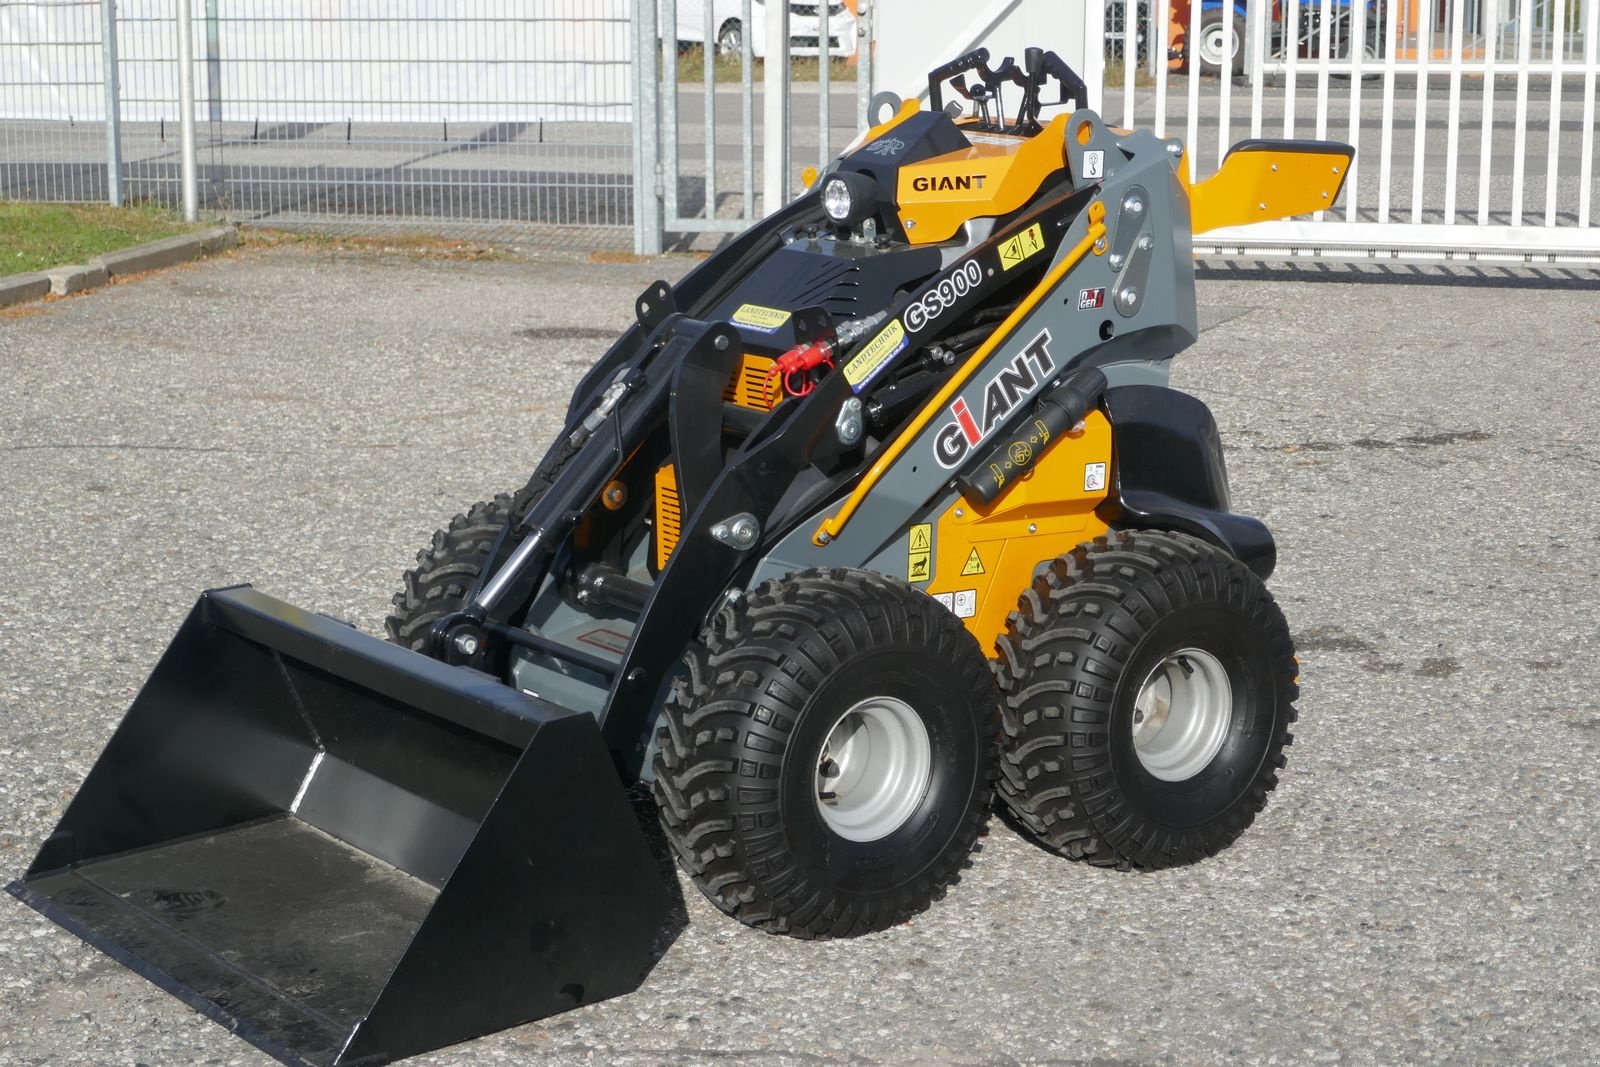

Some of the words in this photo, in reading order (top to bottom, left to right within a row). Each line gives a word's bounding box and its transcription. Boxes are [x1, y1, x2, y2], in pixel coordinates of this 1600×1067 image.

[913, 175, 987, 192] GIANT
[904, 259, 983, 333] GS900
[846, 323, 898, 376] LANDTECHNIK
